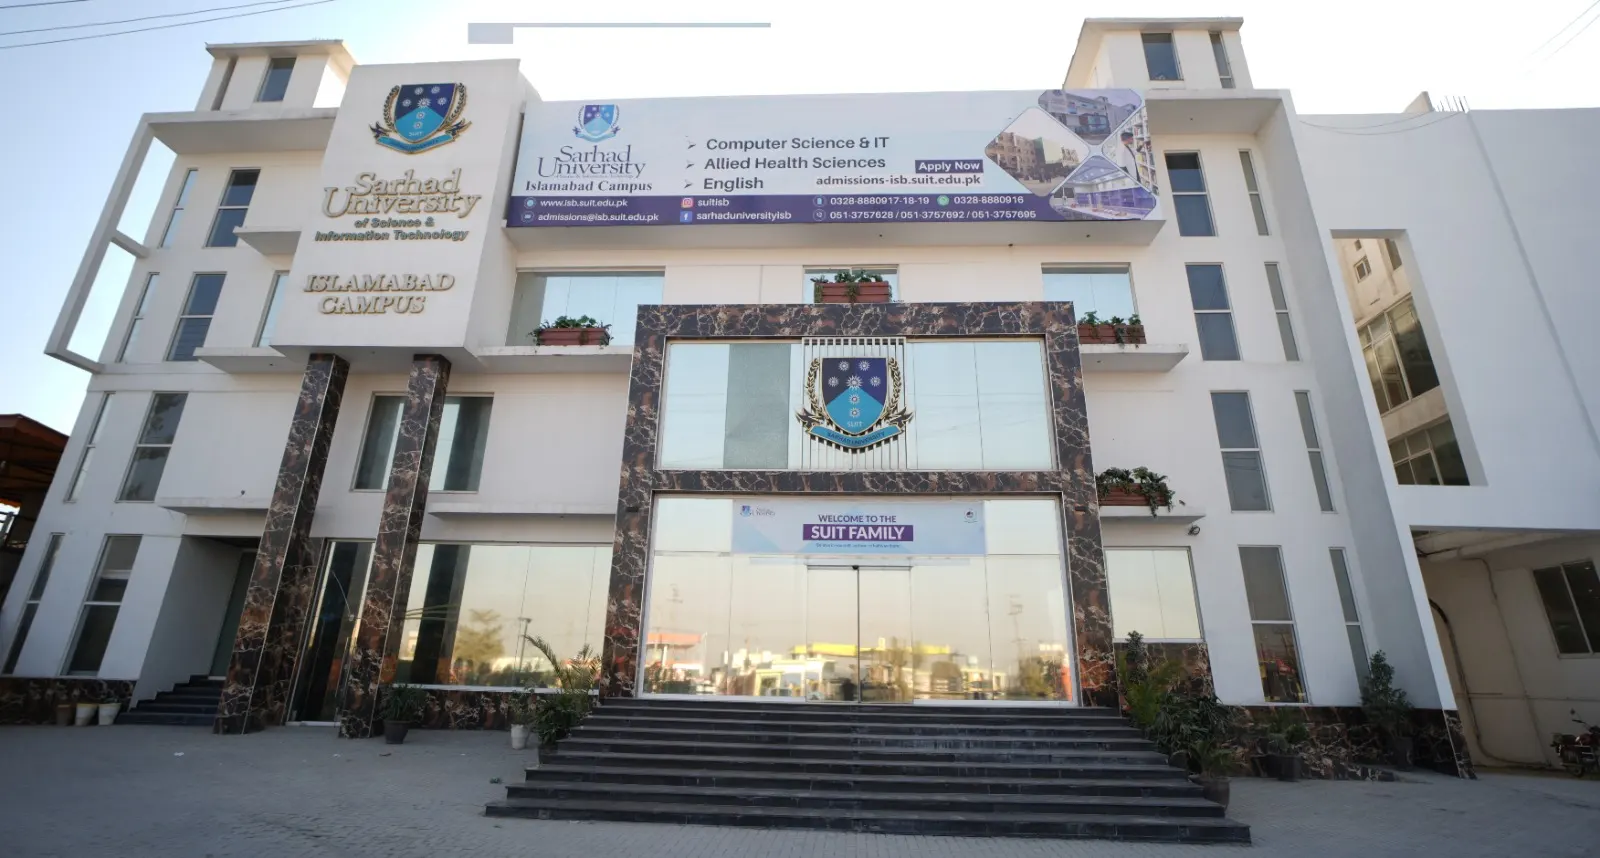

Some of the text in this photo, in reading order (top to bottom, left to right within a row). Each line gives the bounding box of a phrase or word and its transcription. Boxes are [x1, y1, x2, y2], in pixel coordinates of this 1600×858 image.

[706, 137, 890, 152] Computer Science & IT
[560, 144, 632, 163] Sarhad
[537, 156, 646, 178] University
[704, 157, 886, 170] Allied Health Sciences
[919, 162, 980, 172] Apply Now
[354, 168, 462, 196] Sarhad
[525, 180, 652, 193] Islamabad Campus
[703, 177, 764, 192] English
[816, 175, 981, 186] admissions-isb.suit.edu.pk
[322, 186, 482, 218] University
[540, 200, 628, 208] www.isb.suit.edu.pk
[697, 199, 730, 207] suitisb
[830, 196, 930, 205] 0328-8880917-18-19
[953, 195, 1024, 204] 0328-8880916
[538, 213, 660, 222] admissions@isb.suit.edu.pk
[696, 211, 792, 221] sarhaduniversityisb
[830, 211, 894, 219] 051-3757628
[900, 211, 965, 219] 051-3757692
[971, 210, 1037, 219] 051-3757695
[354, 216, 434, 228] of Science &
[315, 229, 468, 241] Information Technology
[303, 273, 455, 293] ISLAMABAD
[318, 295, 426, 314] CAMPUS
[818, 514, 897, 523] WELCOME TO THE
[811, 525, 905, 539] SUIT FAMILY
